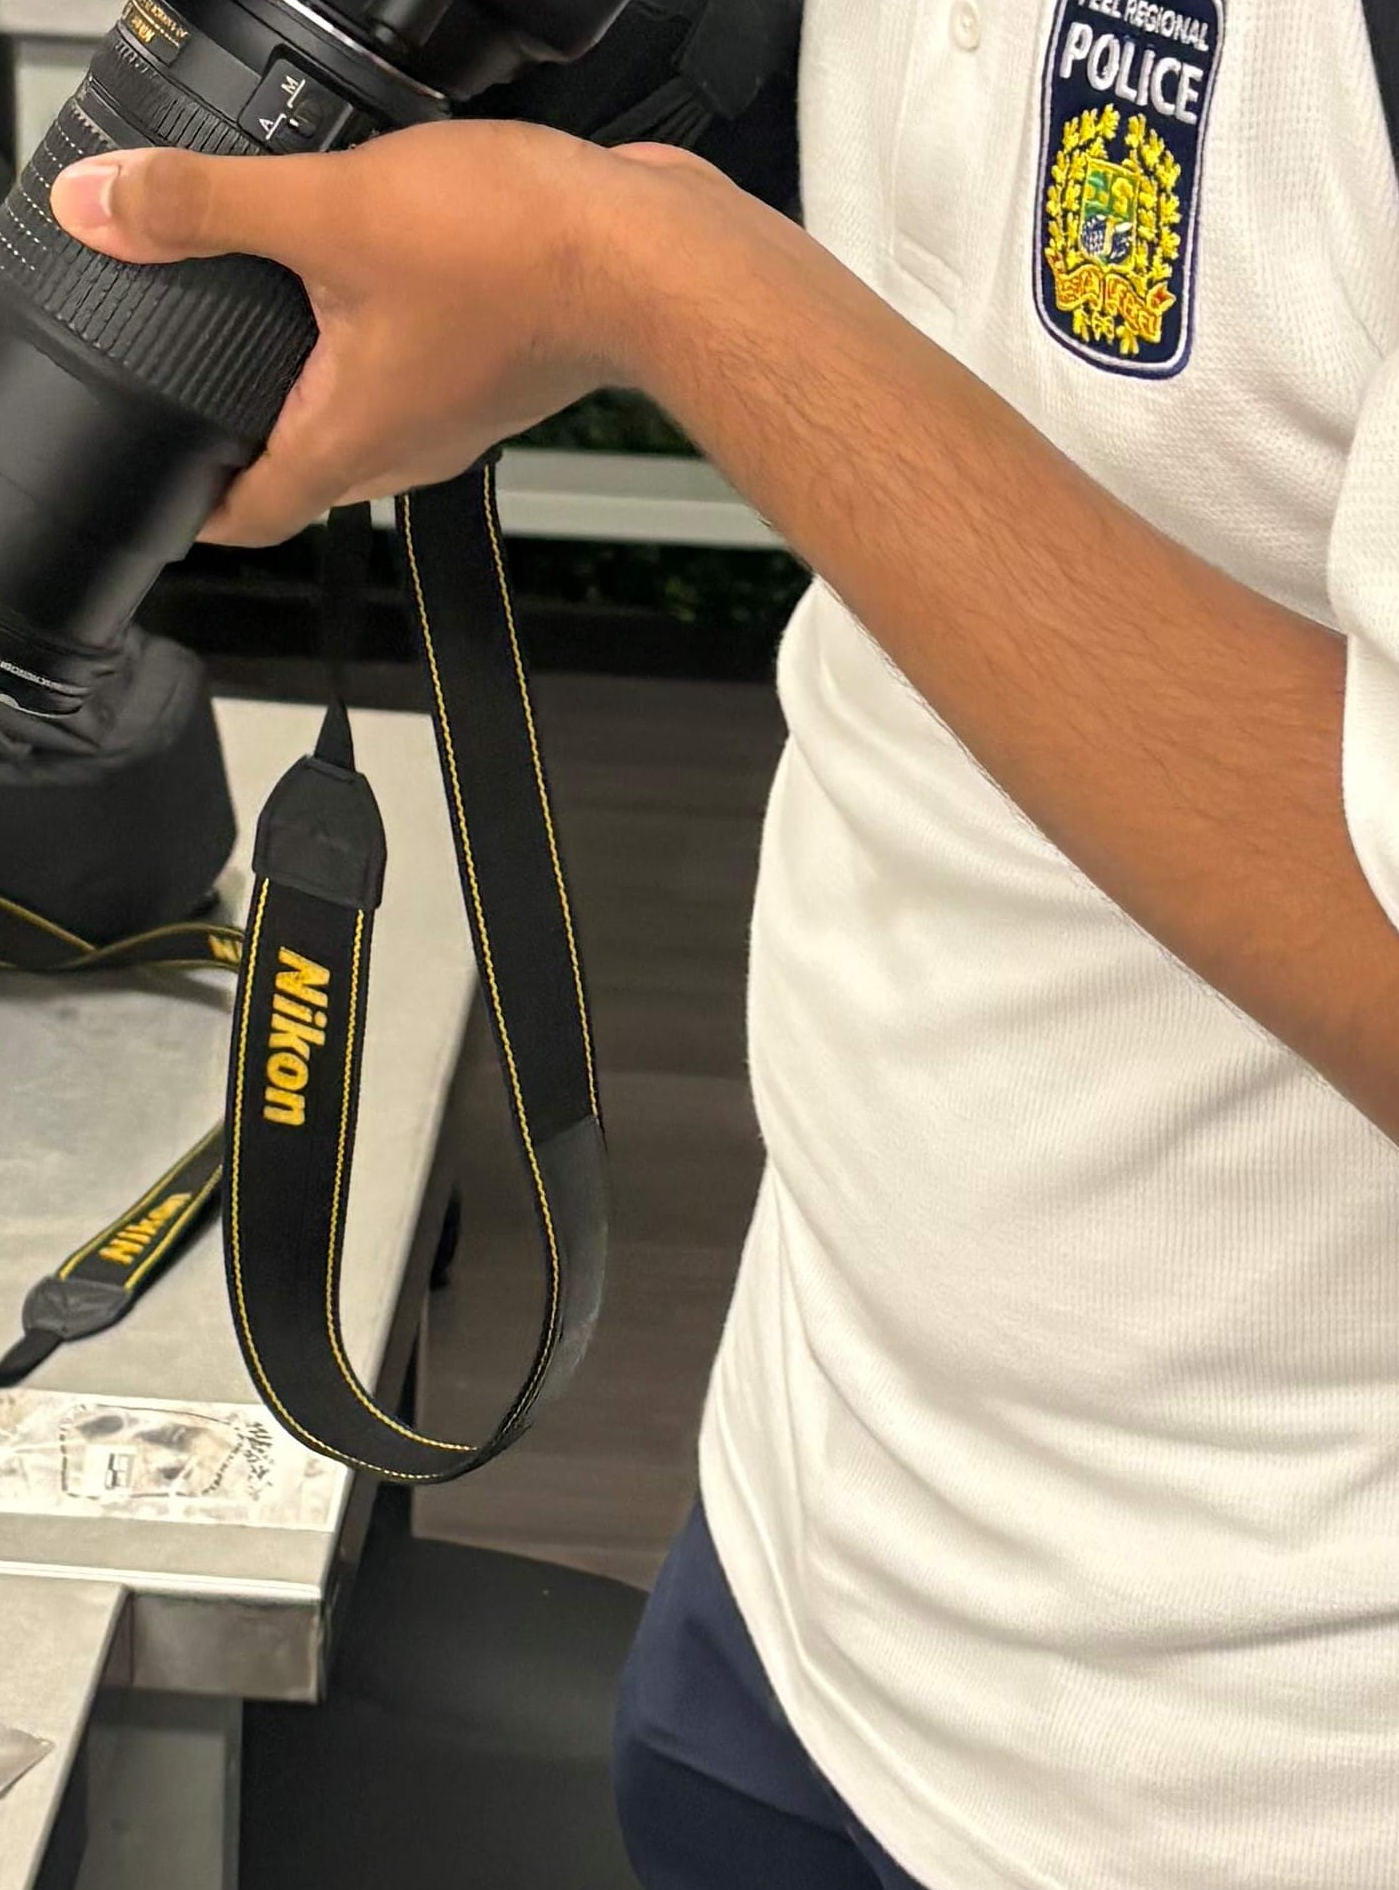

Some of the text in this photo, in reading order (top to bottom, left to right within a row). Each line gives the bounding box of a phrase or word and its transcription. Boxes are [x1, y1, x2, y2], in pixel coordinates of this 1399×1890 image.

[280, 75, 300, 96] M
[1058, 21, 1204, 125] POLICE
[262, 945, 332, 1127] Nikon
[98, 1192, 193, 1265] Nikon
